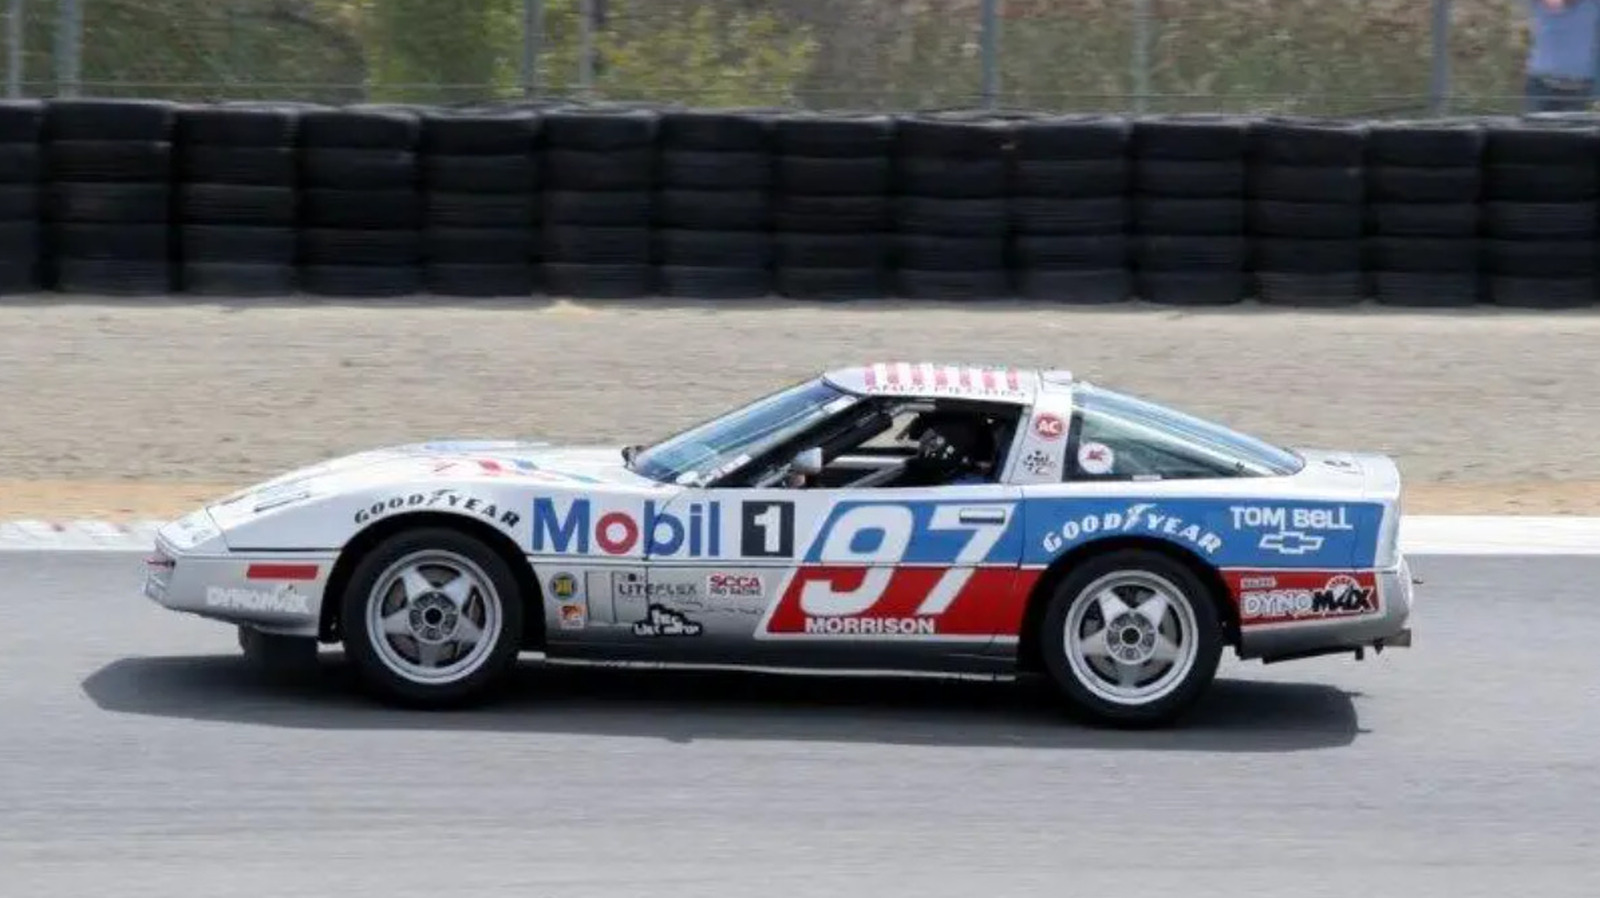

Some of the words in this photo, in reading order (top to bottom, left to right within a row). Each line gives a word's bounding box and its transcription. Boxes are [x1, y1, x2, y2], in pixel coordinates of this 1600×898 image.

[532, 497, 720, 555] Mobil
[1230, 506, 1286, 530] TOM
[800, 502, 1017, 616] 97
[709, 575, 761, 588] SCCA
[1242, 588, 1374, 618] DYNOMAX
[805, 618, 936, 634] MORRISON
